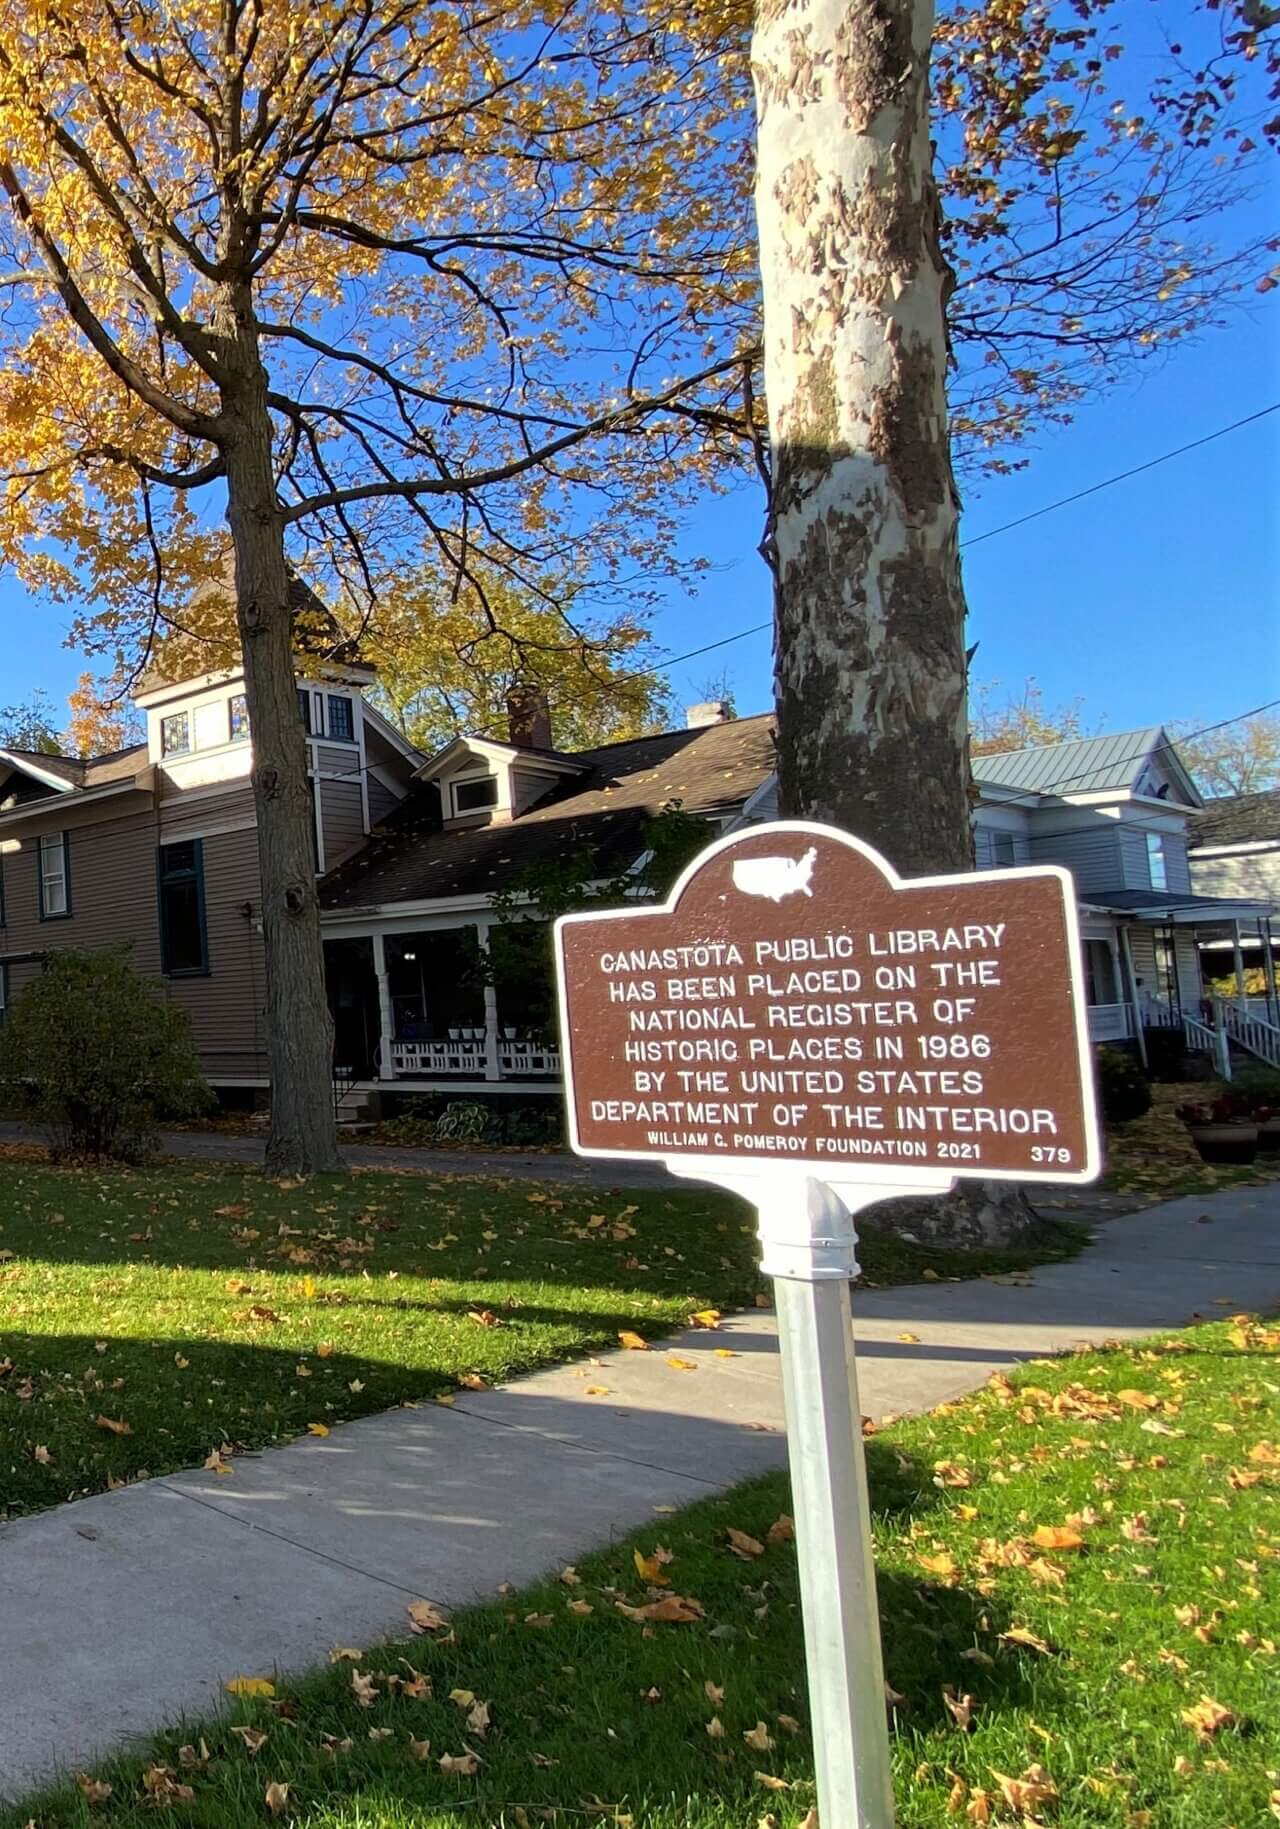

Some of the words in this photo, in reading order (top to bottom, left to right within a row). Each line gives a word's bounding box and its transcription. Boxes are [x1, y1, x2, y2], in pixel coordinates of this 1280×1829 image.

[600, 940, 744, 974] CANASTOTA
[755, 934, 854, 965] PUBLIC
[869, 922, 1006, 956] LIBRARY
[608, 979, 657, 1002] HAS
[667, 975, 737, 1001] BEEN
[747, 968, 862, 997] PLACED
[875, 965, 917, 991] ON
[930, 960, 1001, 988] THE
[629, 1006, 756, 1032] NATIONAL
[767, 1001, 919, 1028] REGISTER
[932, 997, 977, 1025] OF
[624, 1038, 738, 1062] HISTORIC
[749, 1036, 864, 1062] PLACES
[875, 1036, 904, 1060] IN
[917, 1034, 992, 1059] 1986
[634, 1070, 666, 1092] BY
[677, 1070, 730, 1093] THE
[740, 1069, 844, 1094] UNITED
[856, 1070, 984, 1095] STATES
[591, 1100, 759, 1125] DEPARTMENT
[772, 1103, 809, 1127] OF
[822, 1104, 885, 1130] THE
[896, 1105, 1058, 1135] INTERIOR
[647, 1130, 709, 1147] WILLIAM
[733, 1133, 809, 1152] POMEROY
[815, 1137, 928, 1157] FOUNDATION
[936, 1141, 981, 1160] 2021
[1030, 1146, 1072, 1164] 379
